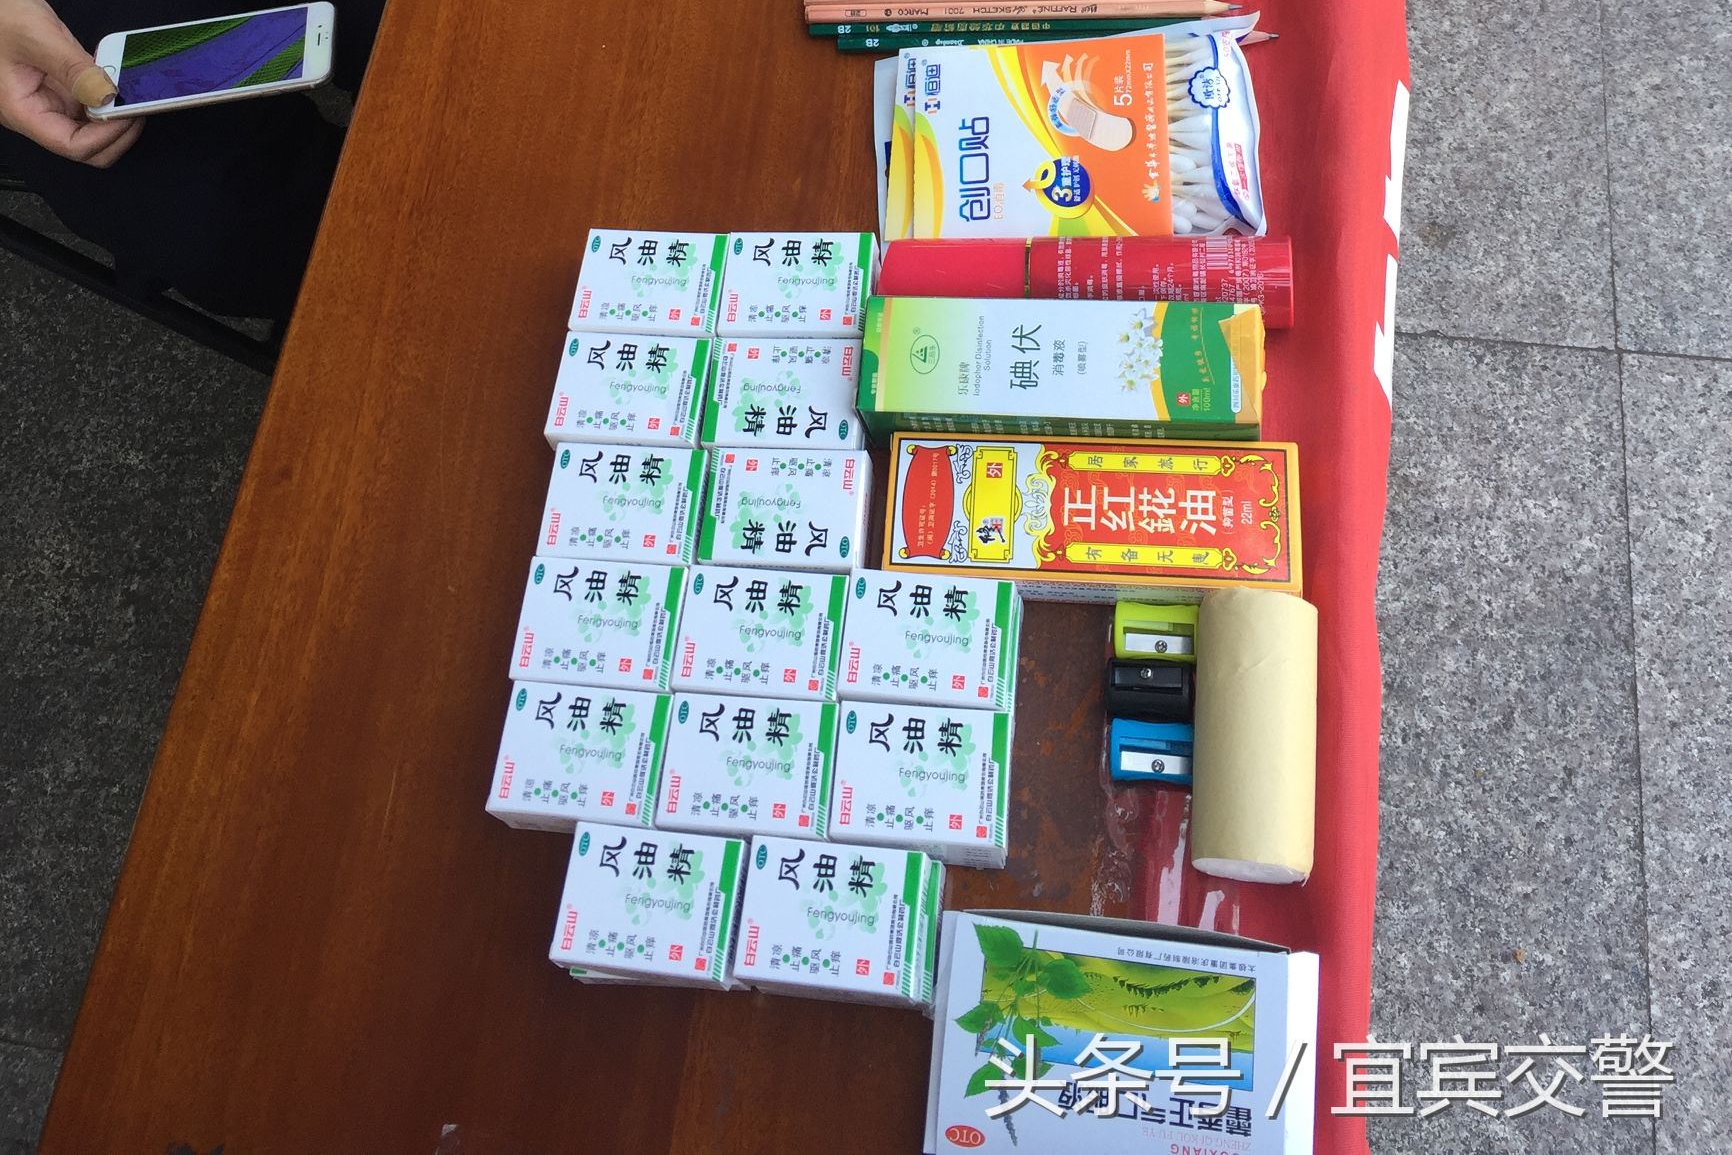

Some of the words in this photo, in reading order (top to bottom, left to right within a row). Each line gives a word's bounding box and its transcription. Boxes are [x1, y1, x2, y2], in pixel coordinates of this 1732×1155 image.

[897, 8, 929, 16] MARCO
[838, 25, 852, 34] 2B
[866, 38, 880, 47] 2B
[958, 116, 991, 222] 创口贴
[609, 237, 689, 267] 风油精
[753, 238, 834, 267] 风油精
[587, 340, 670, 373] 风油精
[1010, 324, 1042, 390] 碘伏
[1052, 339, 1066, 376] 消毒液
[1203, 387, 1211, 412] 100ml
[742, 404, 828, 438] 风油精
[579, 451, 664, 486] 风油精
[986, 462, 1003, 478] 外
[1086, 454, 1208, 472] 居家旅行
[1241, 499, 1253, 526] 22ml
[740, 519, 828, 556] 风油精
[554, 566, 642, 606] 风油精
[714, 576, 803, 616] 风油精
[877, 580, 968, 622] 风油精
[578, 615, 639, 630] Fengyoujing
[740, 626, 802, 640] Fengyoujing
[905, 631, 969, 646] Fengyoujing
[519, 633, 534, 666] 白云山
[681, 643, 696, 677] 白云山
[847, 648, 861, 683] 白云山
[535, 692, 626, 736] 风油精
[699, 703, 792, 746] 风油精
[869, 713, 963, 757] 风油精
[560, 745, 623, 761] Fengyoujing
[727, 757, 791, 772] Fengyoujing
[499, 762, 515, 798] 白云山
[899, 768, 966, 783] Fengyoujing
[666, 776, 681, 813] 白云山
[840, 787, 853, 824] 白云山
[599, 836, 695, 885] 风油精
[778, 849, 875, 897] 风油精
[625, 894, 691, 912] Fengyoujing
[807, 907, 875, 926] Fengyoujing
[561, 911, 578, 950] 白云山
[744, 926, 760, 966] 白云山
[948, 1130, 982, 1145] OTC
